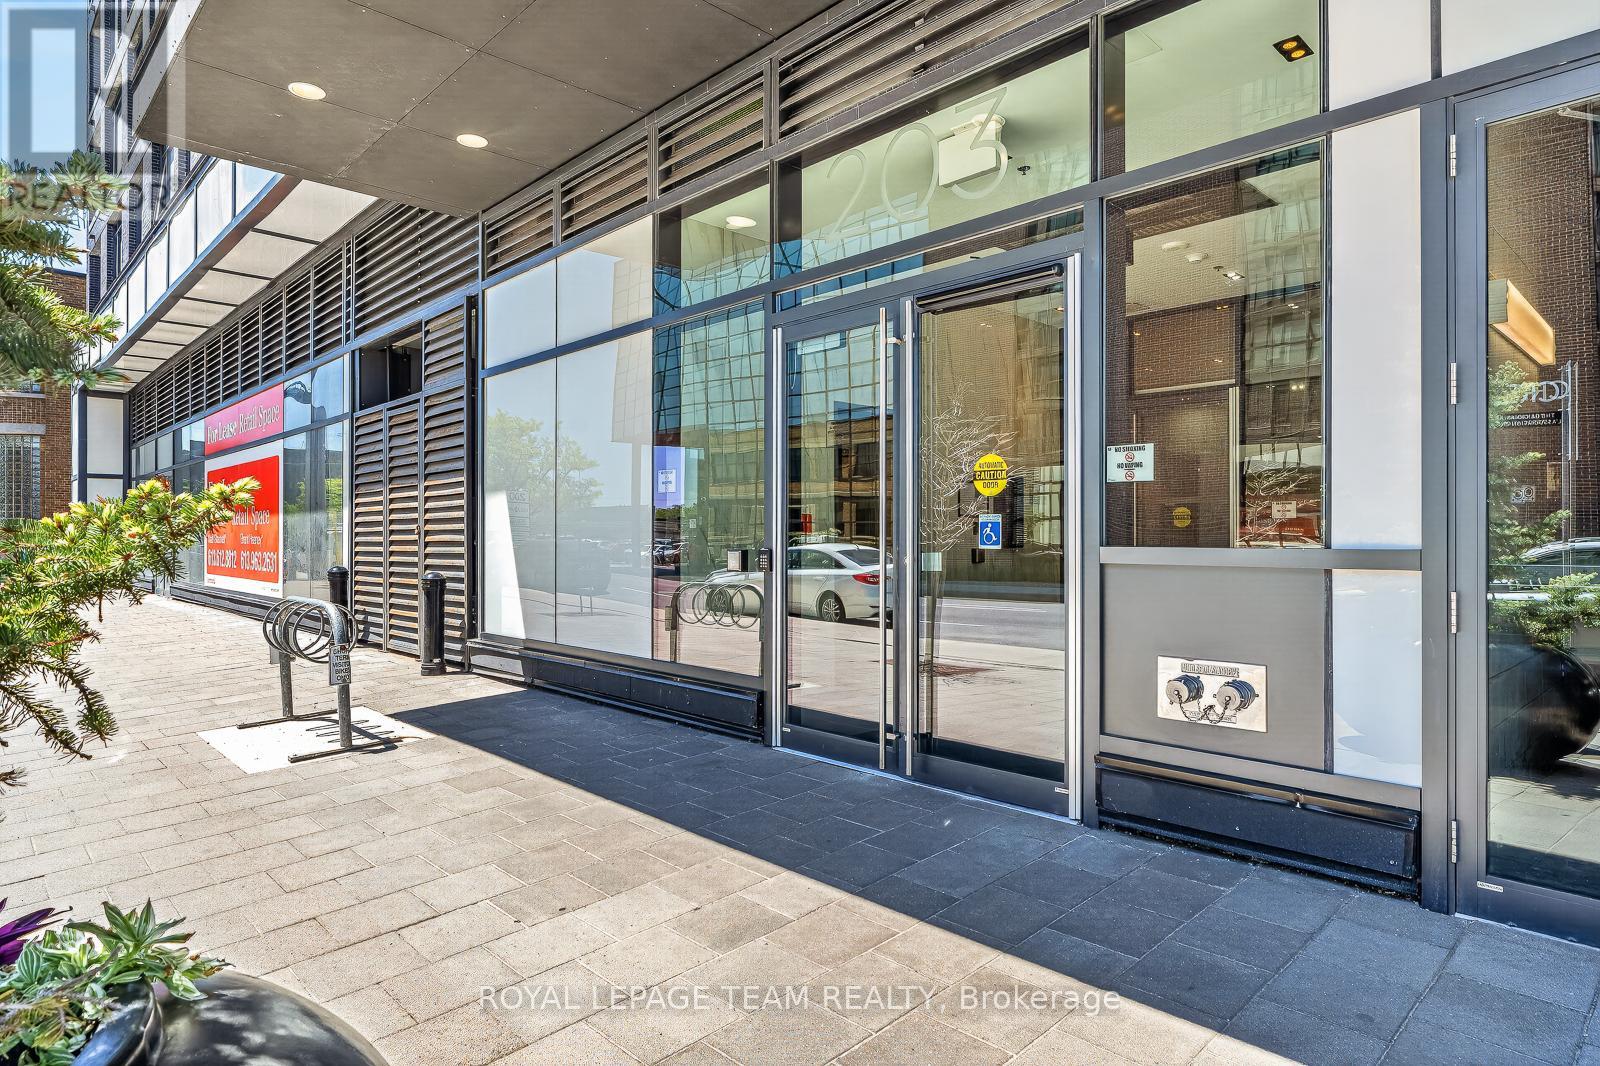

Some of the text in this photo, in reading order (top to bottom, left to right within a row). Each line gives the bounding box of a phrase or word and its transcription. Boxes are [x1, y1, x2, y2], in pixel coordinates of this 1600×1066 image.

[827, 86, 1009, 242] 203
[207, 404, 280, 444] For Lease Retail Space
[975, 470, 1006, 480] CAUTION
[251, 505, 270, 531] Space
